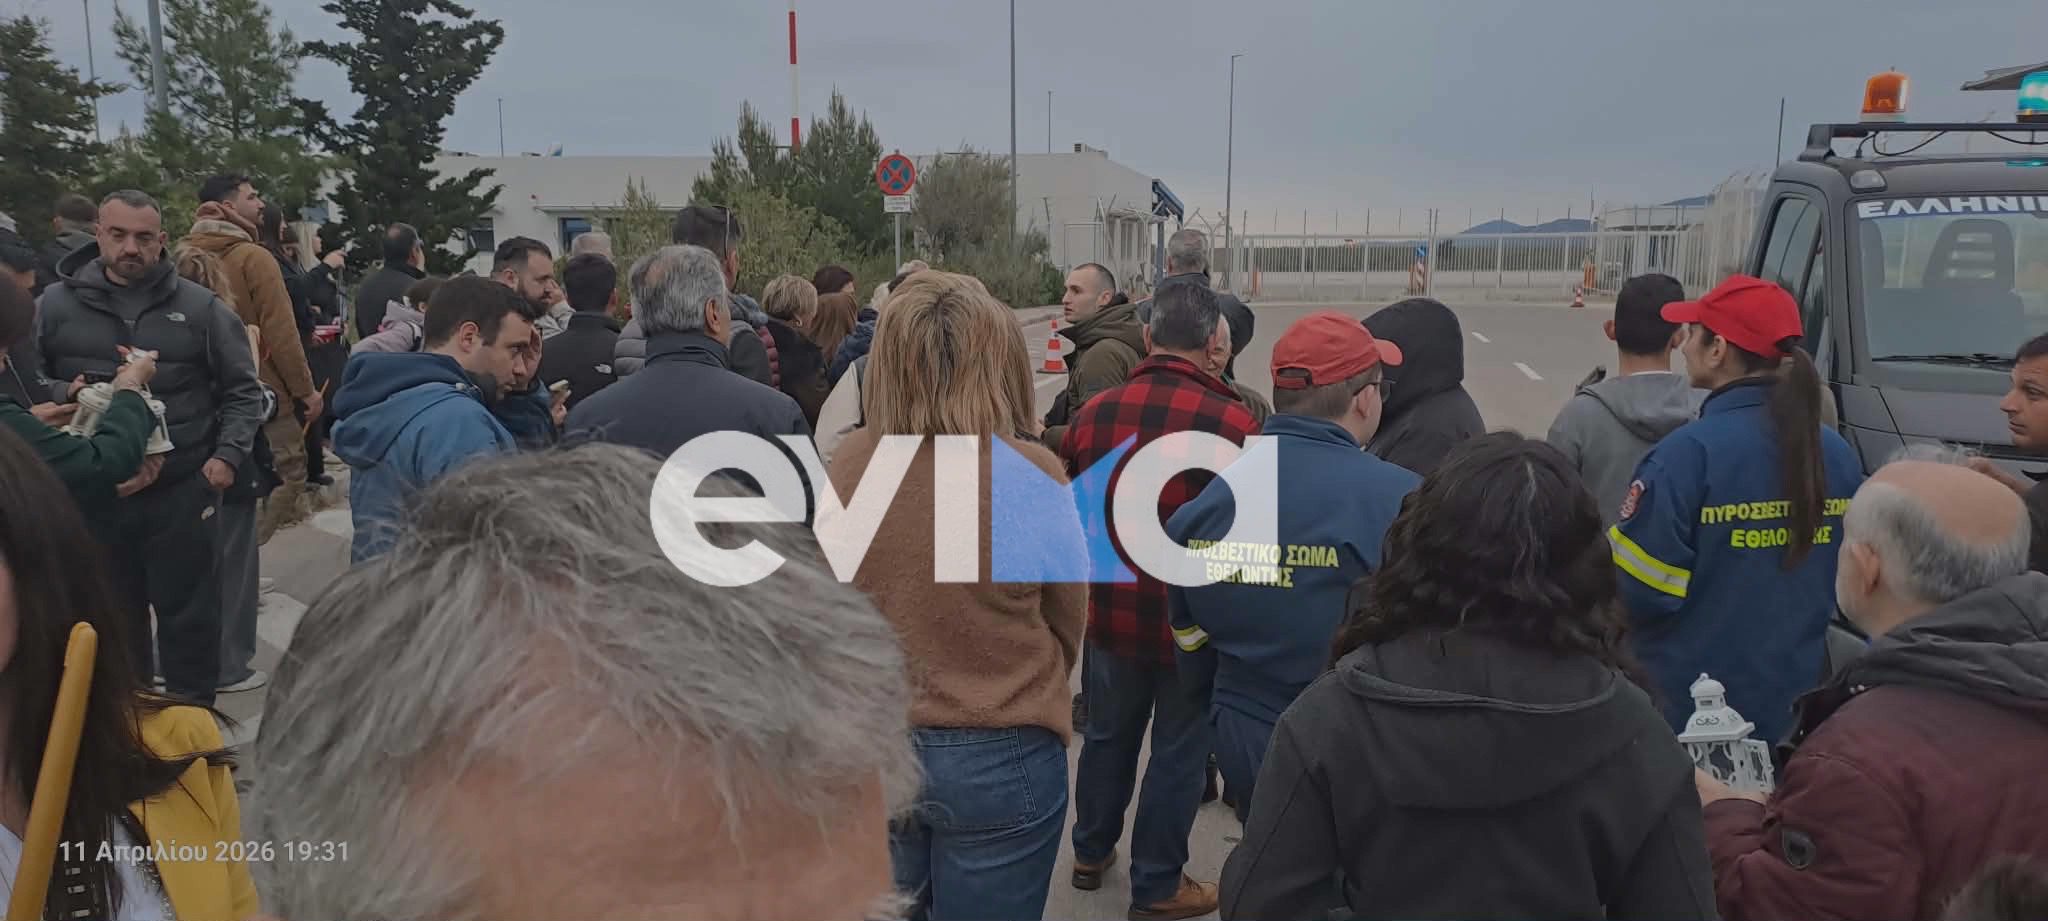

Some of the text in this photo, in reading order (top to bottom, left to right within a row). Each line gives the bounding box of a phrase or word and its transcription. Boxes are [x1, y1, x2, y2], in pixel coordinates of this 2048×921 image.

[1857, 196, 2048, 219] ΕΛΛΗΝΙ
[1731, 526, 1832, 548] ΕΘΕΛΟΗΣ
[1285, 544, 1340, 567] ΣΩΜΑ
[1206, 562, 1294, 588] ΕΘΕΛΟΝΤΗΣ
